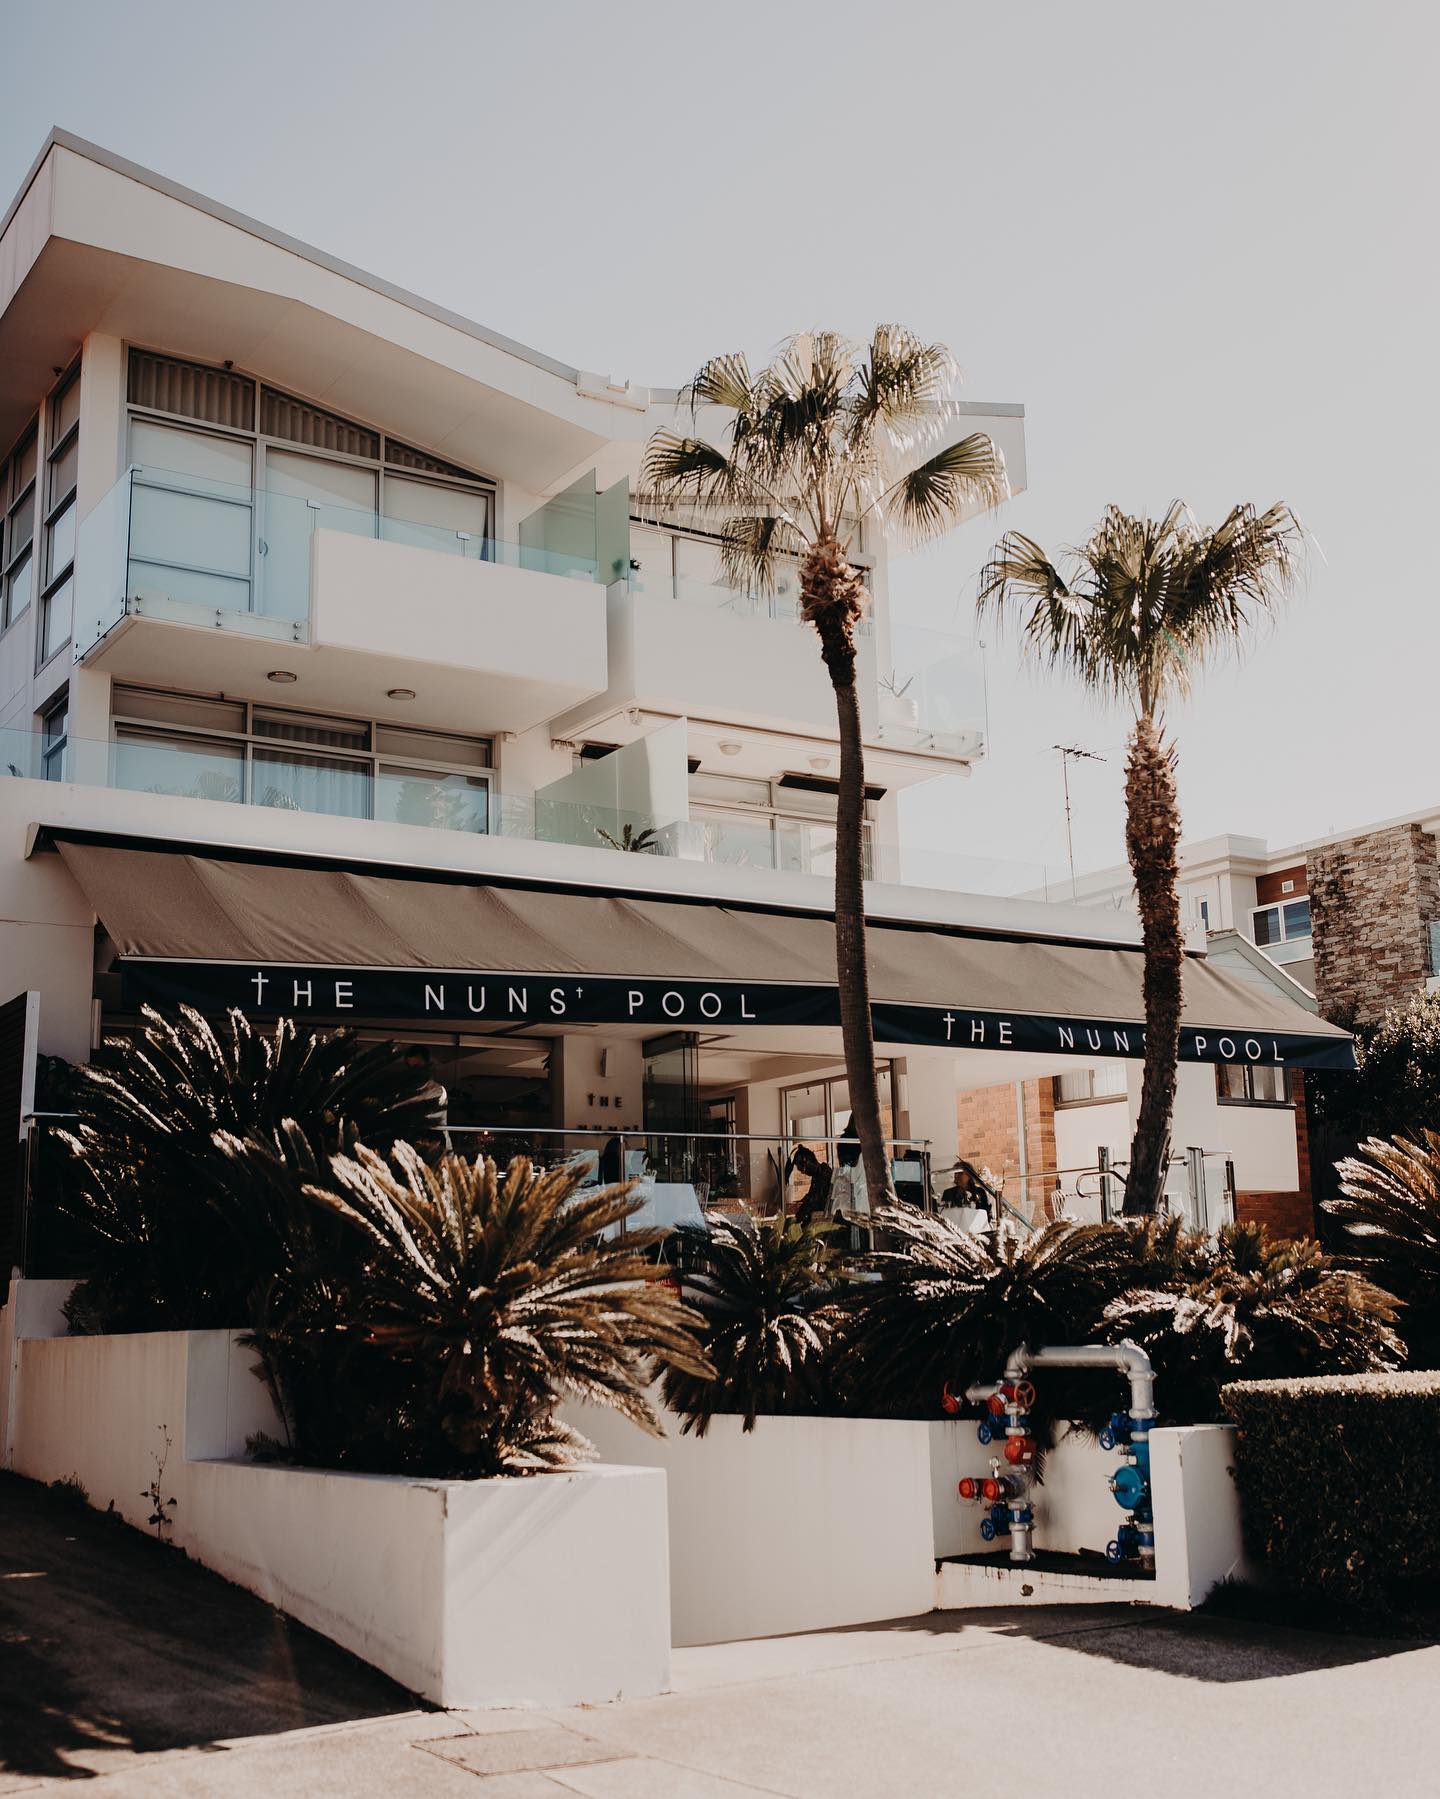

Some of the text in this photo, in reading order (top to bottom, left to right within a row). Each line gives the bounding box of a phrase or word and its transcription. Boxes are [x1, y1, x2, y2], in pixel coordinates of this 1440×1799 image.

[627, 990, 757, 1019] POOL
[1057, 1026, 1147, 1055] NUN
[1194, 1035, 1285, 1061] POOL
